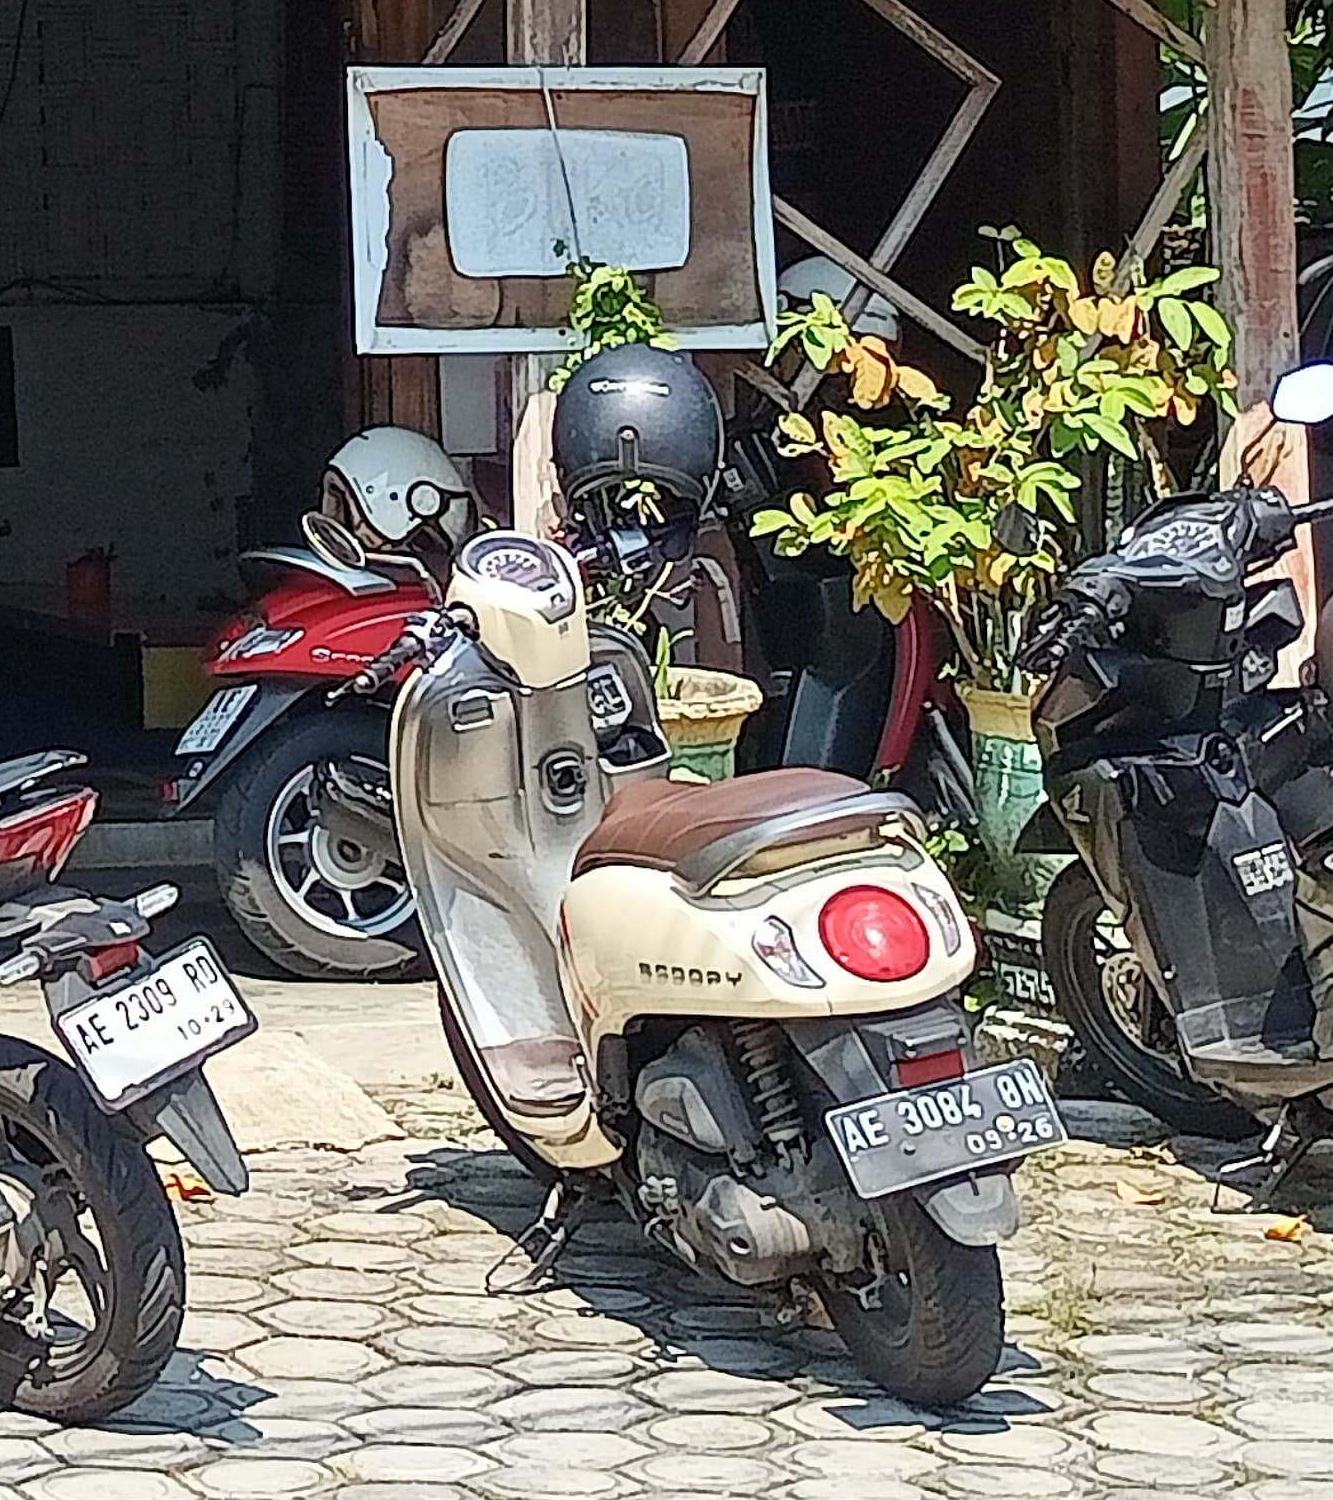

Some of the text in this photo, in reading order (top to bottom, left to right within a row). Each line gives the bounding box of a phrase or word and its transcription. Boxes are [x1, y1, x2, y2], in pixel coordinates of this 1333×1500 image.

[76, 1013, 114, 1054] AE
[115, 978, 177, 1030] 2309
[842, 1110, 889, 1152] AE
[897, 1084, 982, 1135] 3084
